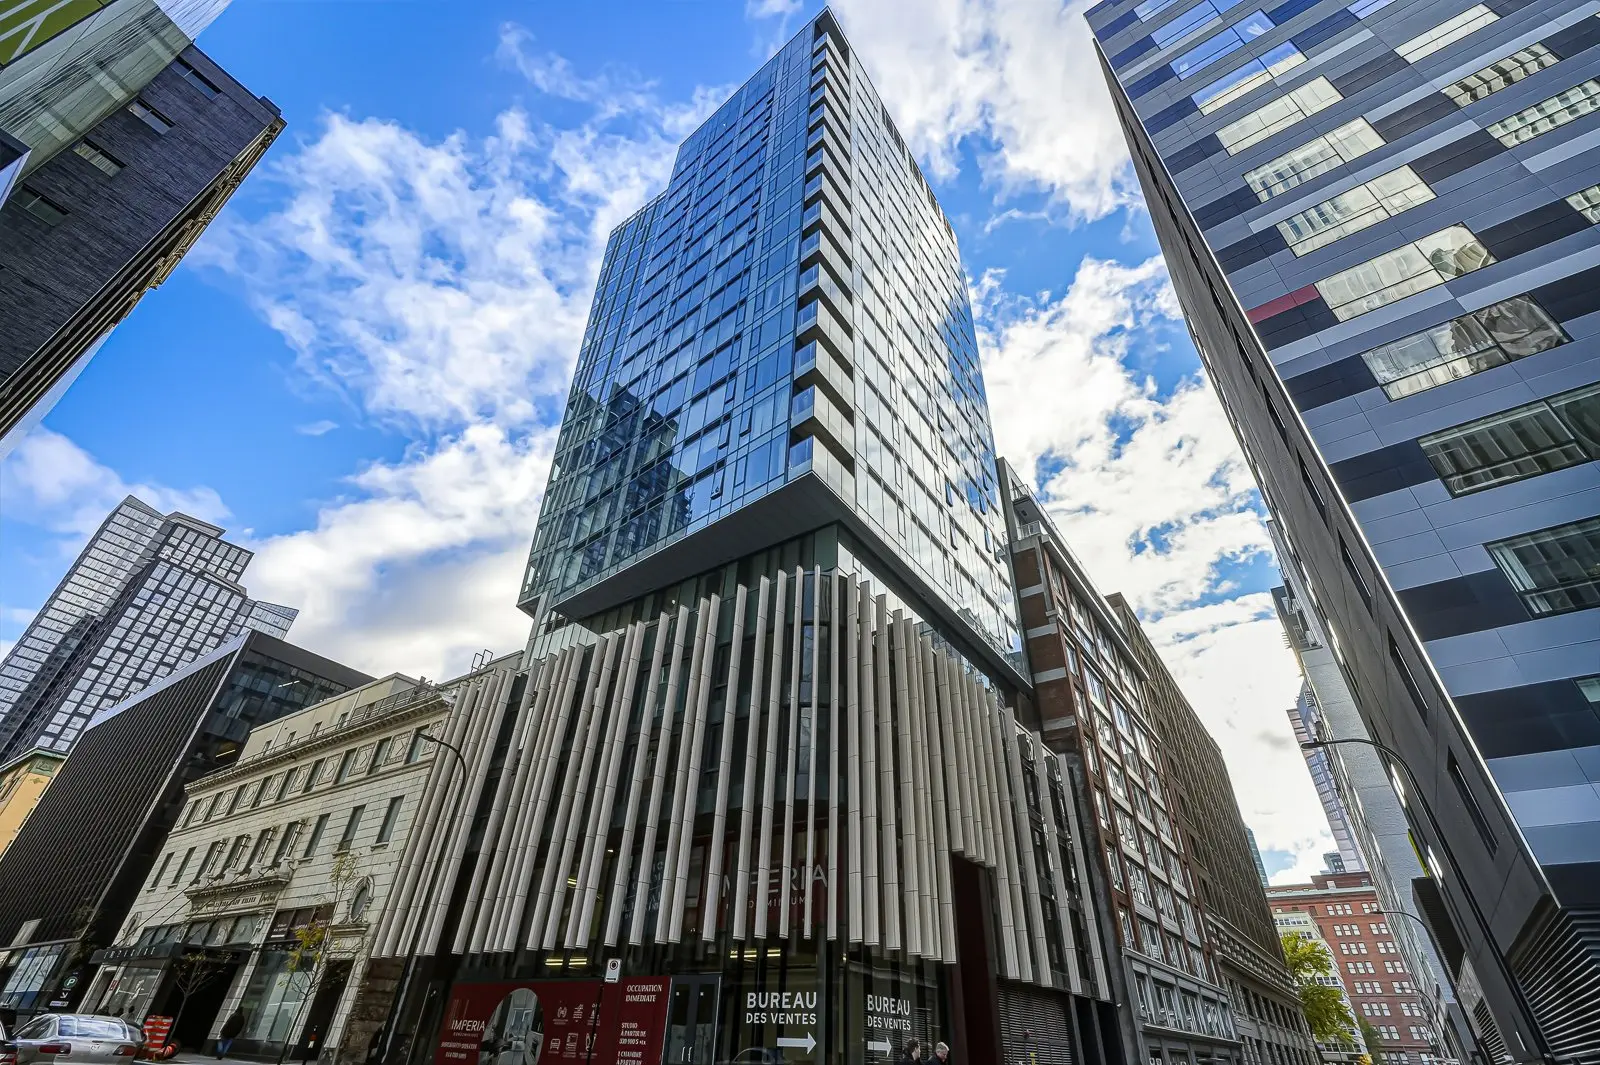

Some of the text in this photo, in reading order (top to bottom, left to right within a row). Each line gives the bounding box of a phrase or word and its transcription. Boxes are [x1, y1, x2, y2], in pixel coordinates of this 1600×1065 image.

[627, 984, 662, 992] OCCUPATION
[625, 993, 657, 1002] IMMÉDIATE
[746, 991, 817, 1009] BUREAU
[867, 994, 910, 1016] BUREAU
[746, 1012, 817, 1025] DES VENTES
[867, 1015, 911, 1031] DES VENTES
[451, 1019, 486, 1032] IMPERIA
